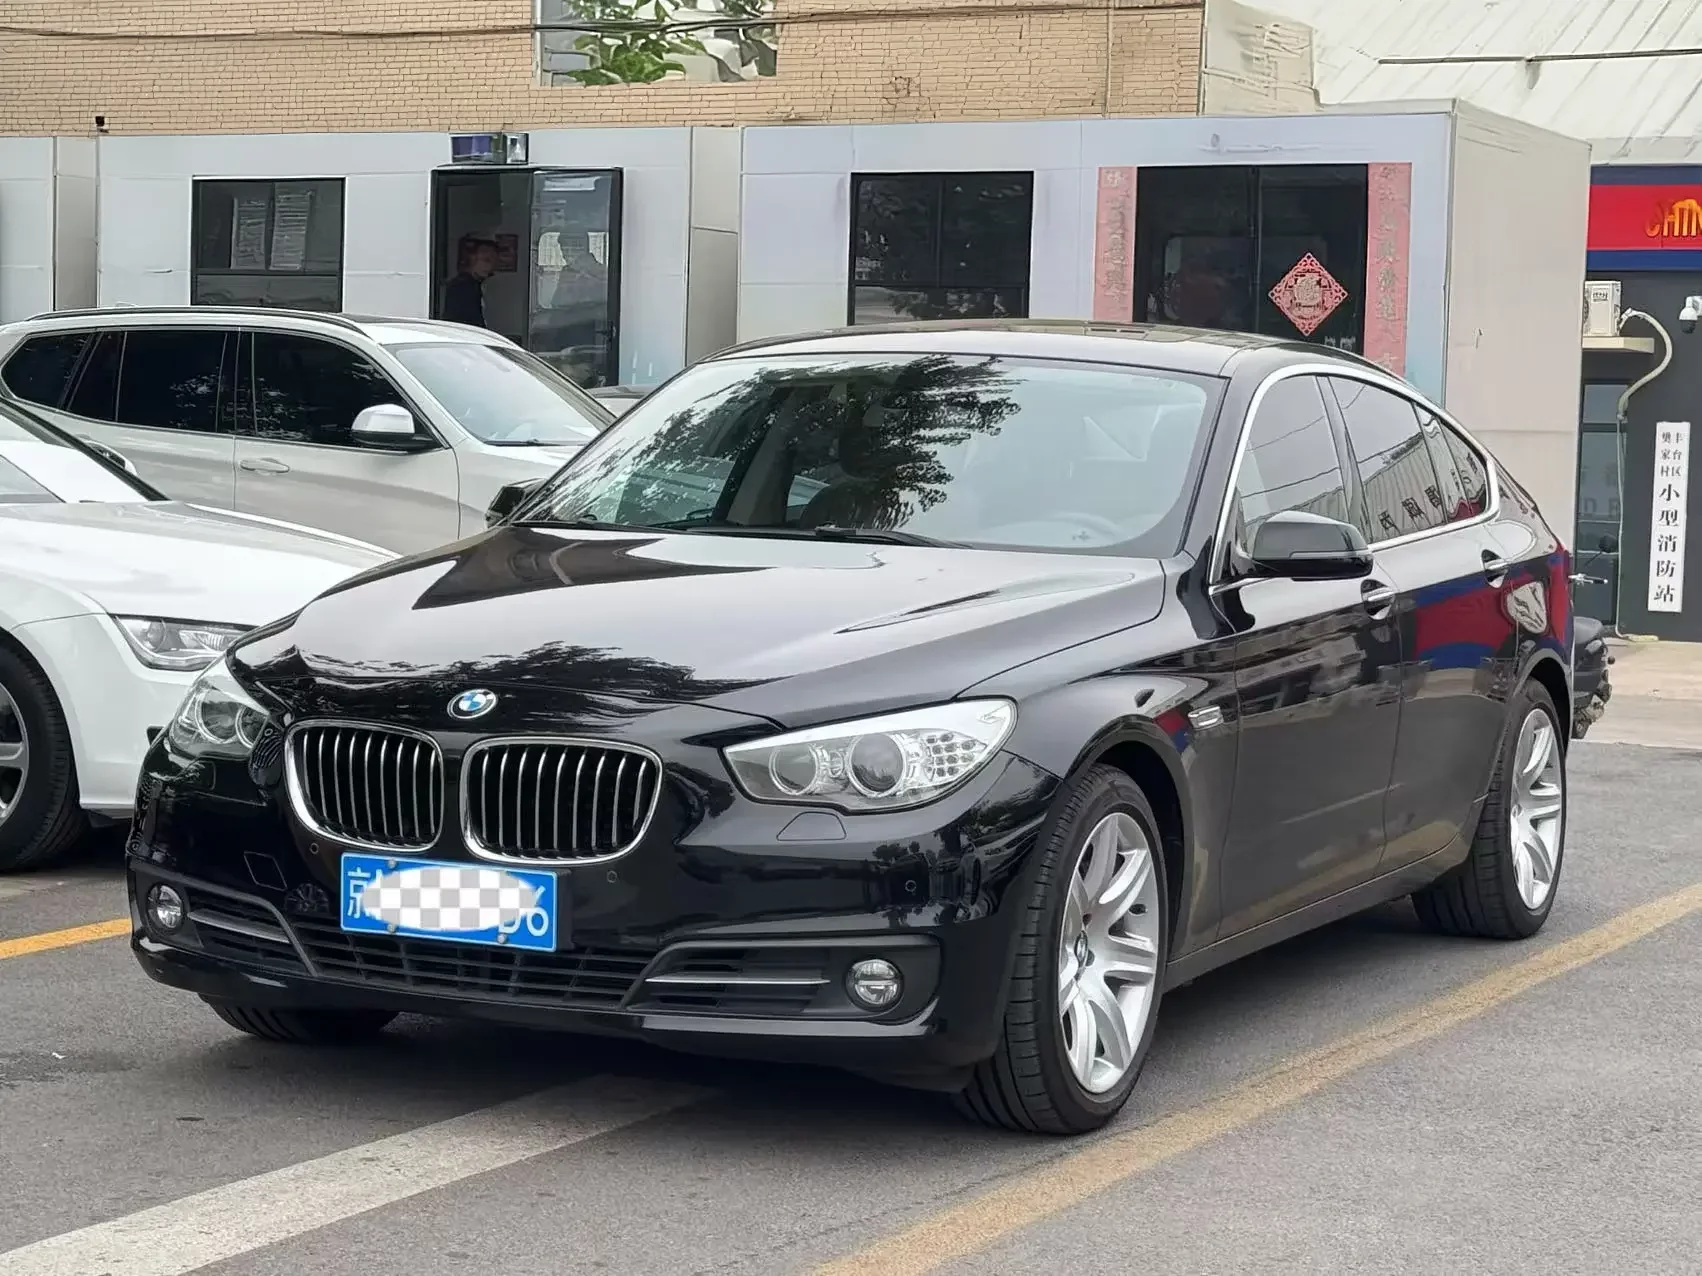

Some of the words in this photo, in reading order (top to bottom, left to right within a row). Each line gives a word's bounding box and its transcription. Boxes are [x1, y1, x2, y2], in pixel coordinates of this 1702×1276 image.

[1653, 483, 1680, 603] 小型消防站
